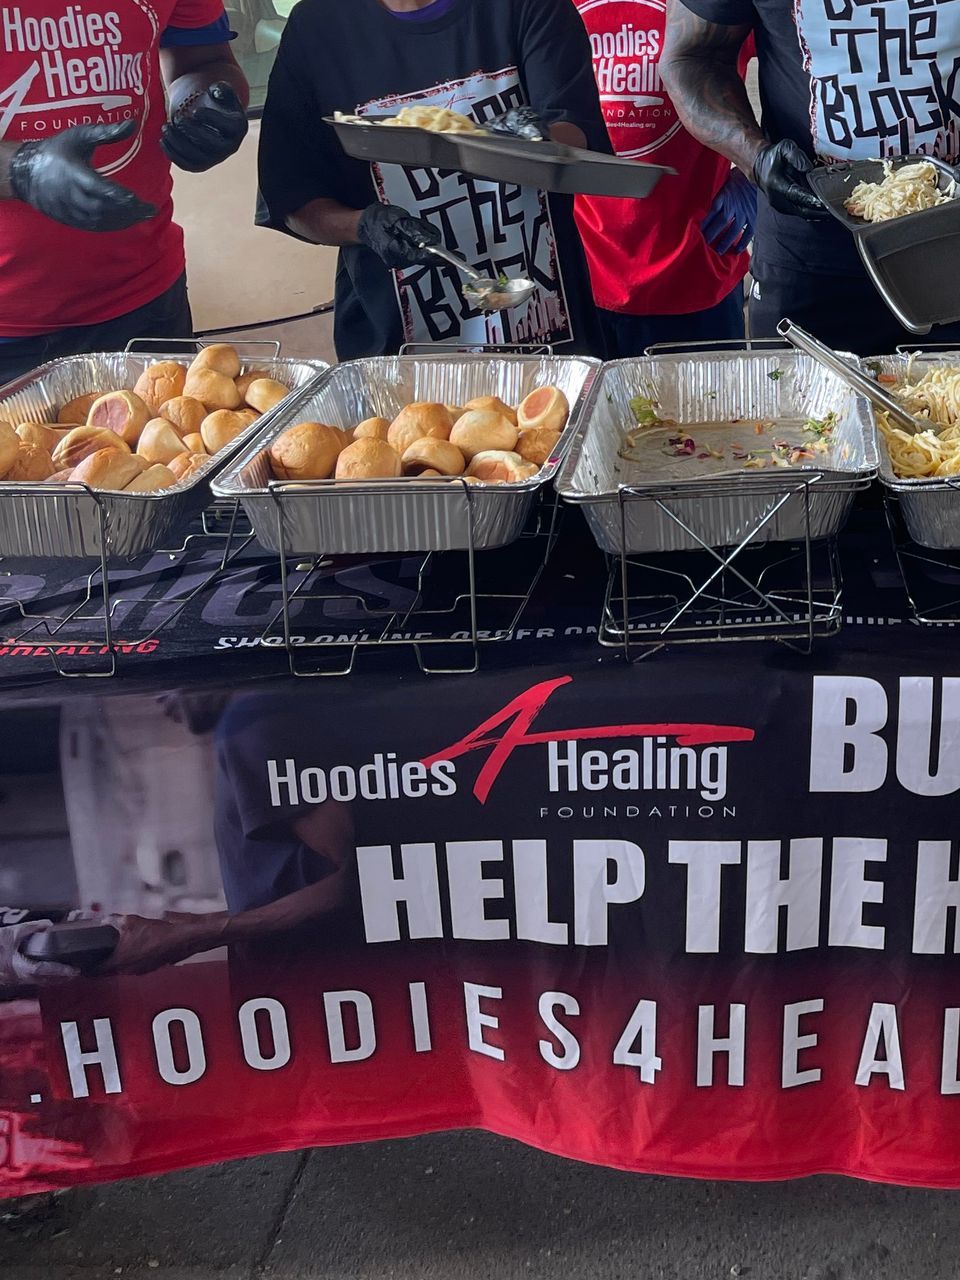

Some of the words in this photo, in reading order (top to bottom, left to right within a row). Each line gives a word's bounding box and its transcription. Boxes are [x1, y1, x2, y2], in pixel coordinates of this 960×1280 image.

[2, 5, 122, 52] Hoodies
[589, 23, 659, 59] oodies
[42, 45, 143, 98] Healing
[597, 54, 667, 93] Heali
[602, 109, 672, 119] NDATION
[267, 751, 458, 807] Hoodies
[548, 737, 730, 800] Healing
[539, 805, 739, 819] FOUNDATION
[355, 839, 647, 946] HELP
[667, 837, 888, 954] THE
